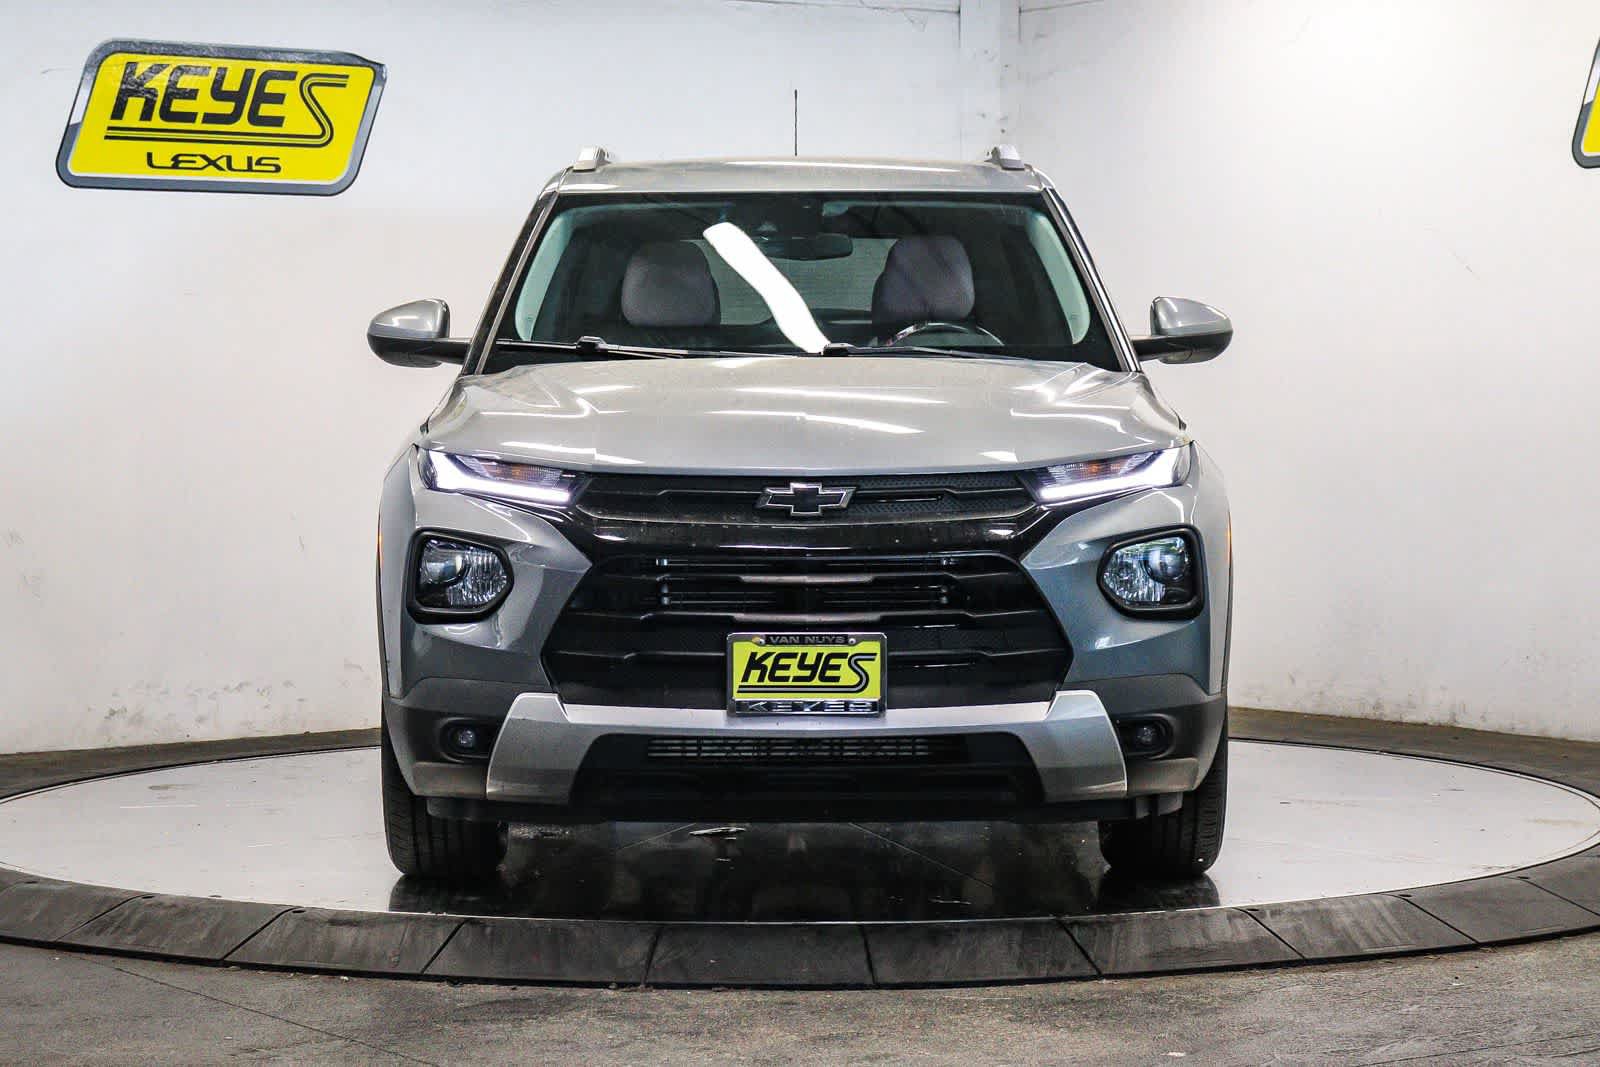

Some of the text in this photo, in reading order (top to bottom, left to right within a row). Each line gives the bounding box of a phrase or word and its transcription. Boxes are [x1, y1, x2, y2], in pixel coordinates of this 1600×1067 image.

[104, 61, 349, 148] KEYES
[147, 152, 281, 174] LEXUS
[769, 635, 845, 644] VAN NUYS
[737, 651, 877, 693] KEYES
